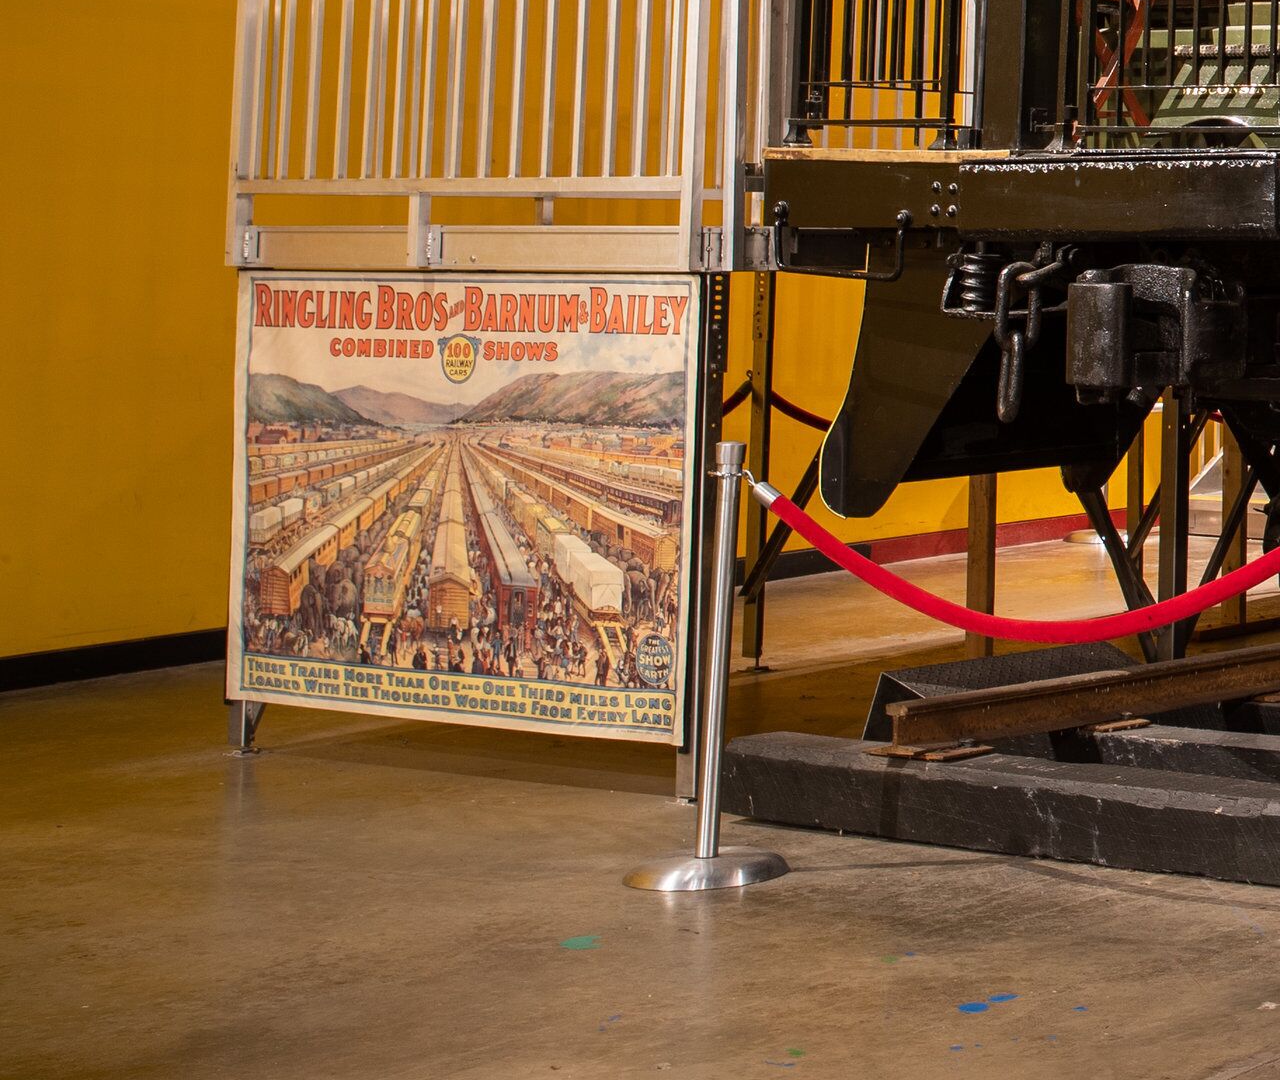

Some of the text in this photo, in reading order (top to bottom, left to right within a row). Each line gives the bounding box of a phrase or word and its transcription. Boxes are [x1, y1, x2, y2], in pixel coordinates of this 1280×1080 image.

[254, 283, 373, 330] RINGLING
[375, 285, 448, 331] BROS
[462, 286, 580, 333] BARNUM
[579, 300, 590, 325] &
[588, 287, 689, 335] BAILEY
[329, 337, 559, 362] COMBINED SHOWS
[447, 342, 471, 358] 100
[445, 359, 474, 368] RAILWAY
[639, 653, 671, 667] SHOW
[639, 666, 669, 679] EARTH
[247, 657, 673, 711] THESE TRAINS MORE THAN ONE AND ONE THIRD MILES LONG
[248, 672, 672, 727] LOADED WITH TEN THOUSAND WONDERS FROM EVERY LAND
